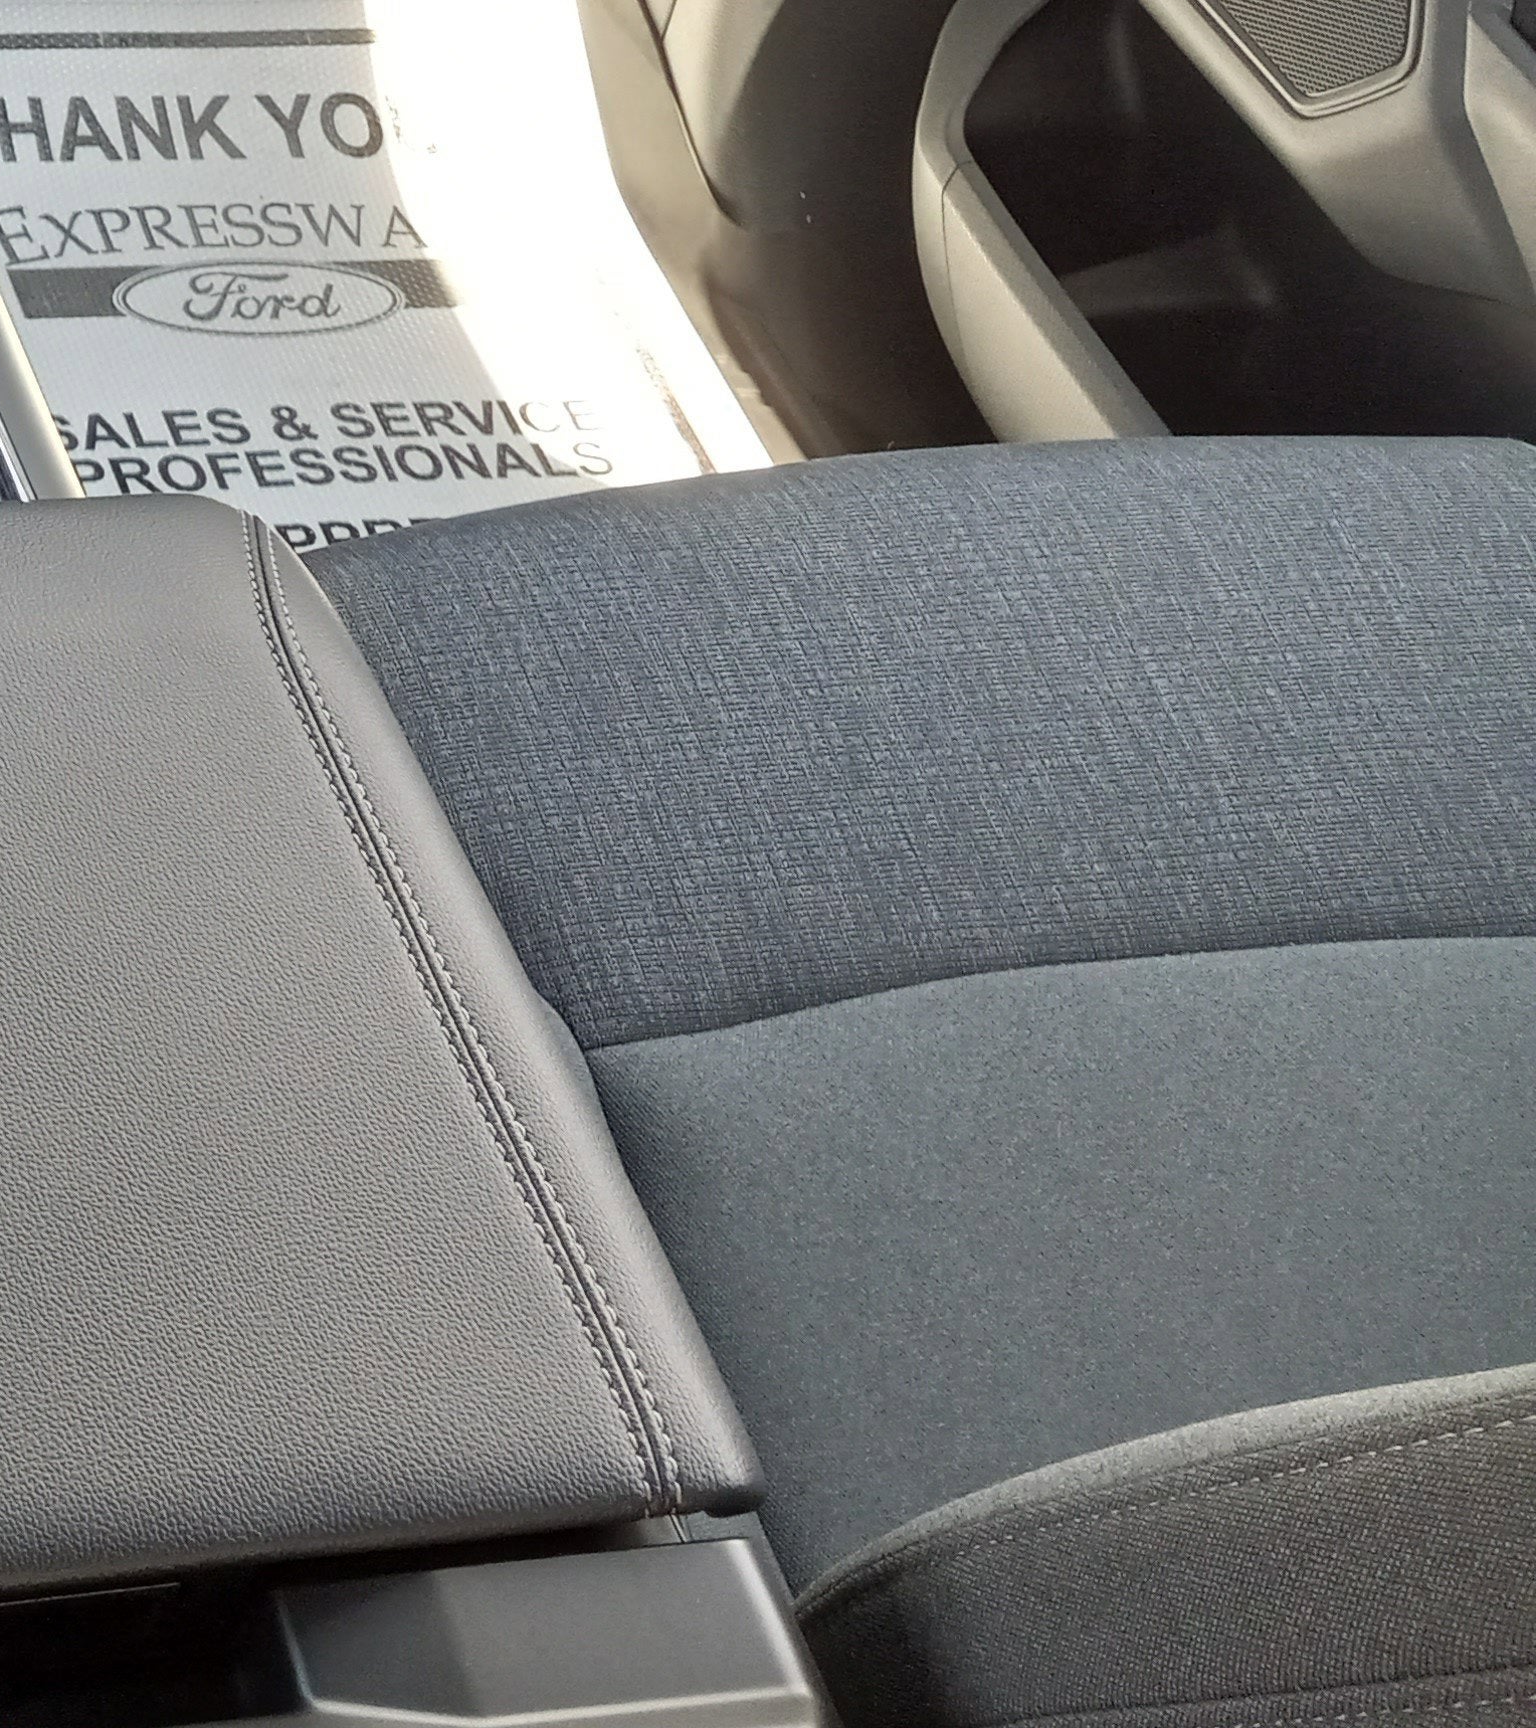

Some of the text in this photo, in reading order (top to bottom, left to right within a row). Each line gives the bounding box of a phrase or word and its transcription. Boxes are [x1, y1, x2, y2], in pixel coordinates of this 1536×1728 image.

[256, 92, 403, 161] YO
[183, 274, 339, 322] Ford
[273, 405, 318, 442] &
[334, 399, 602, 441] SERVICE
[72, 441, 614, 496] PROFESSIONALS
